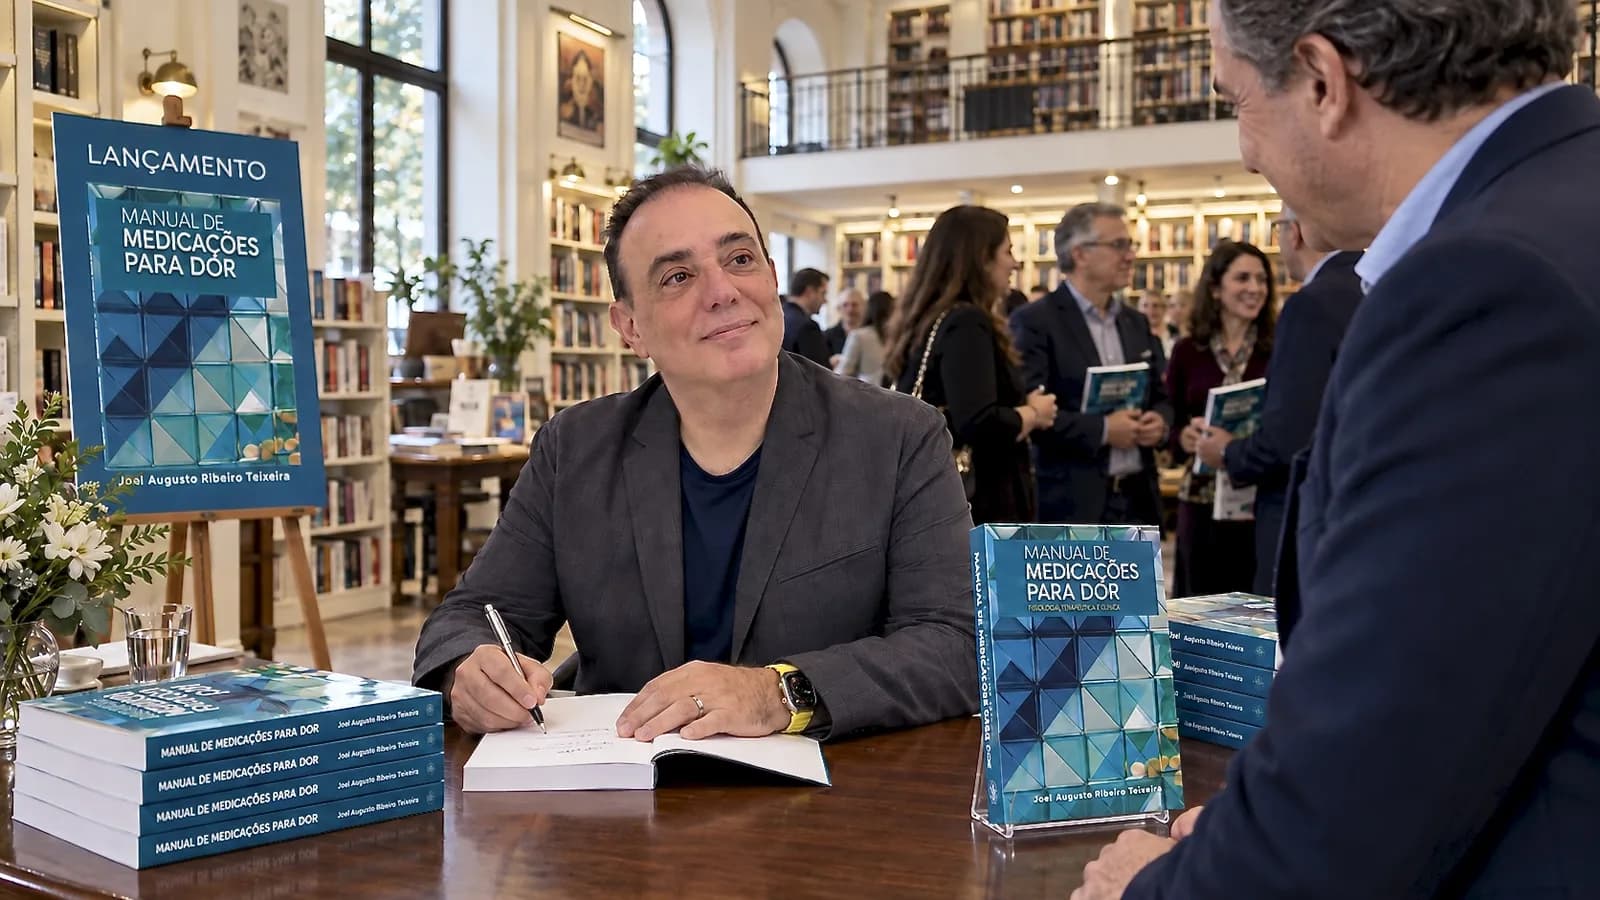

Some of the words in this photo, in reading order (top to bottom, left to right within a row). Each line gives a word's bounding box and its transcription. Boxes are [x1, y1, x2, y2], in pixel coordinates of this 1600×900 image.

[88, 144, 266, 181] LANÇAMENTO
[122, 207, 200, 230] MANUAL
[203, 213, 224, 232] DE
[124, 228, 260, 258] MEDICAÇÕES
[125, 252, 184, 276] PARA
[190, 256, 236, 278] DOR
[118, 475, 144, 487] Joel
[148, 474, 198, 488] Augusto
[201, 472, 242, 484] Ribeiro
[246, 470, 290, 482] Teixeira
[1024, 545, 1091, 560] MANUAL
[1094, 545, 1110, 560] DE
[1026, 559, 1140, 583] MEDICAÇÕES
[1027, 583, 1076, 601] PARA
[1080, 583, 1120, 600] DOR
[160, 743, 199, 758] MANUAL
[201, 740, 214, 751] DE
[215, 731, 272, 750] MEDICAÇÕES
[274, 728, 298, 740] PARA
[300, 724, 320, 736] DOR
[158, 776, 197, 792] MANUAL
[198, 774, 211, 784] DE
[212, 763, 272, 782] MEDICAÇÕES
[273, 759, 297, 772] PARA
[300, 755, 319, 766] DOR
[156, 808, 196, 824] MANUAL
[198, 804, 210, 815] DE
[212, 792, 270, 812] MEDICAÇÕES
[272, 789, 296, 802] PARA
[299, 784, 318, 796] DOR
[1034, 795, 1052, 804] Joel
[1056, 792, 1093, 802] Augusto
[1094, 788, 1126, 798] Ribeiro
[156, 838, 195, 854] MANUAL
[197, 834, 209, 846] DE
[211, 822, 270, 842] MEDICAÇÕES
[272, 818, 296, 831] PARA
[298, 814, 318, 826] DOR
